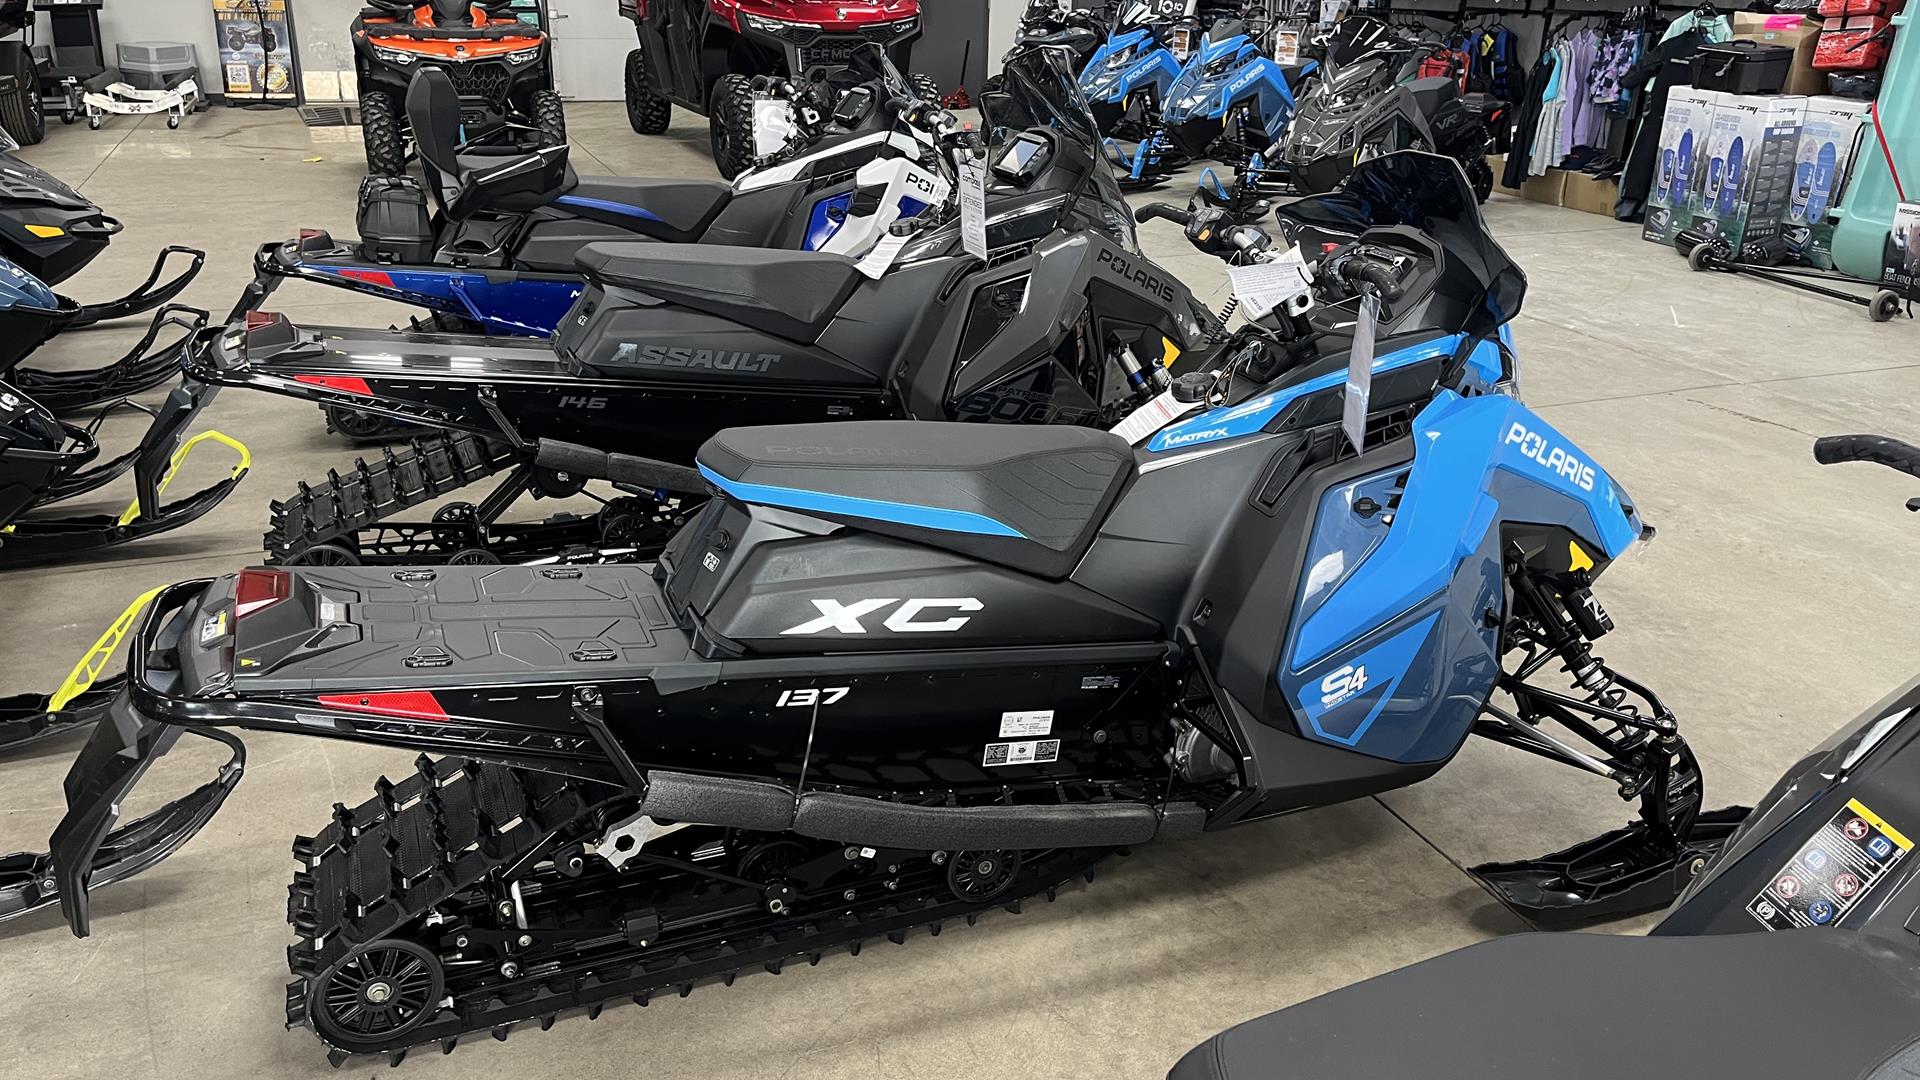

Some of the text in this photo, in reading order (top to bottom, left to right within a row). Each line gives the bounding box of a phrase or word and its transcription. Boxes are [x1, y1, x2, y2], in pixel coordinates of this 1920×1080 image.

[1125, 55, 1162, 82] POLARIS
[1229, 63, 1266, 93] POLARIS
[1360, 95, 1401, 129] POLARIS
[1096, 247, 1175, 303] POLARIS
[611, 342, 783, 373] ASSAULT
[557, 396, 609, 410] 146
[766, 444, 934, 458] POLARIS
[1163, 427, 1229, 449] MATRYX
[1504, 421, 1596, 492] POLARIS
[778, 597, 985, 635] XC
[775, 686, 850, 708] 137
[1321, 665, 1368, 704] S4
